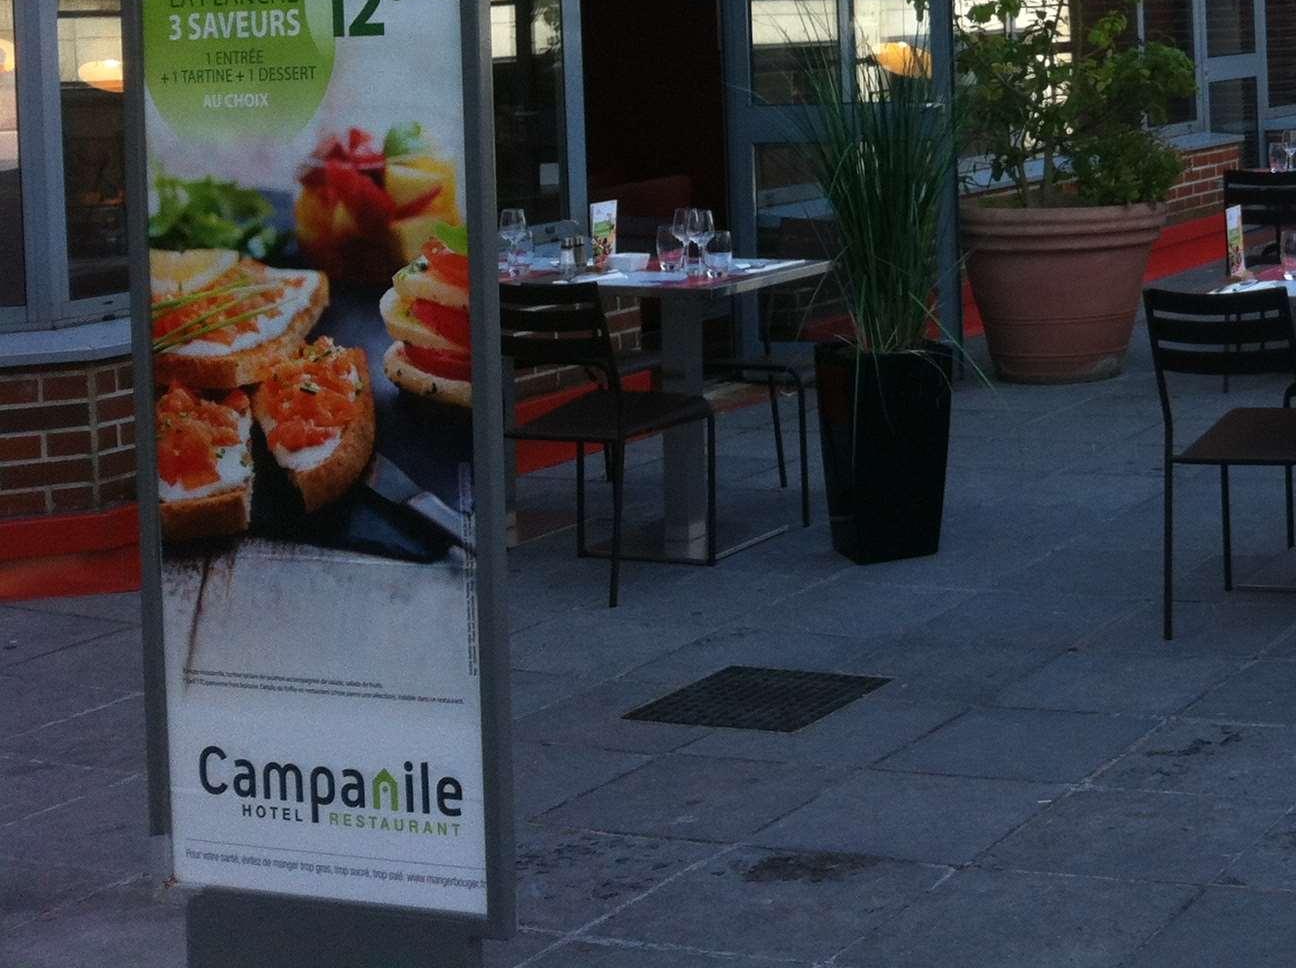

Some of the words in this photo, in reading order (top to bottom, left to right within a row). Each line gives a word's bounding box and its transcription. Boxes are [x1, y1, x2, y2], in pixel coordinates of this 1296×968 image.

[168, 14, 182, 41] 3
[188, 8, 301, 41] SAVEURS
[216, 48, 265, 65] ENTRÉE
[182, 68, 233, 84] TARTINE
[259, 65, 317, 82] DESSERT
[203, 94, 222, 109] AU
[224, 92, 270, 109] CHOIX
[199, 744, 463, 823] Campanile
[242, 803, 304, 822] HOTEL
[328, 811, 463, 836] RESTAURANT
